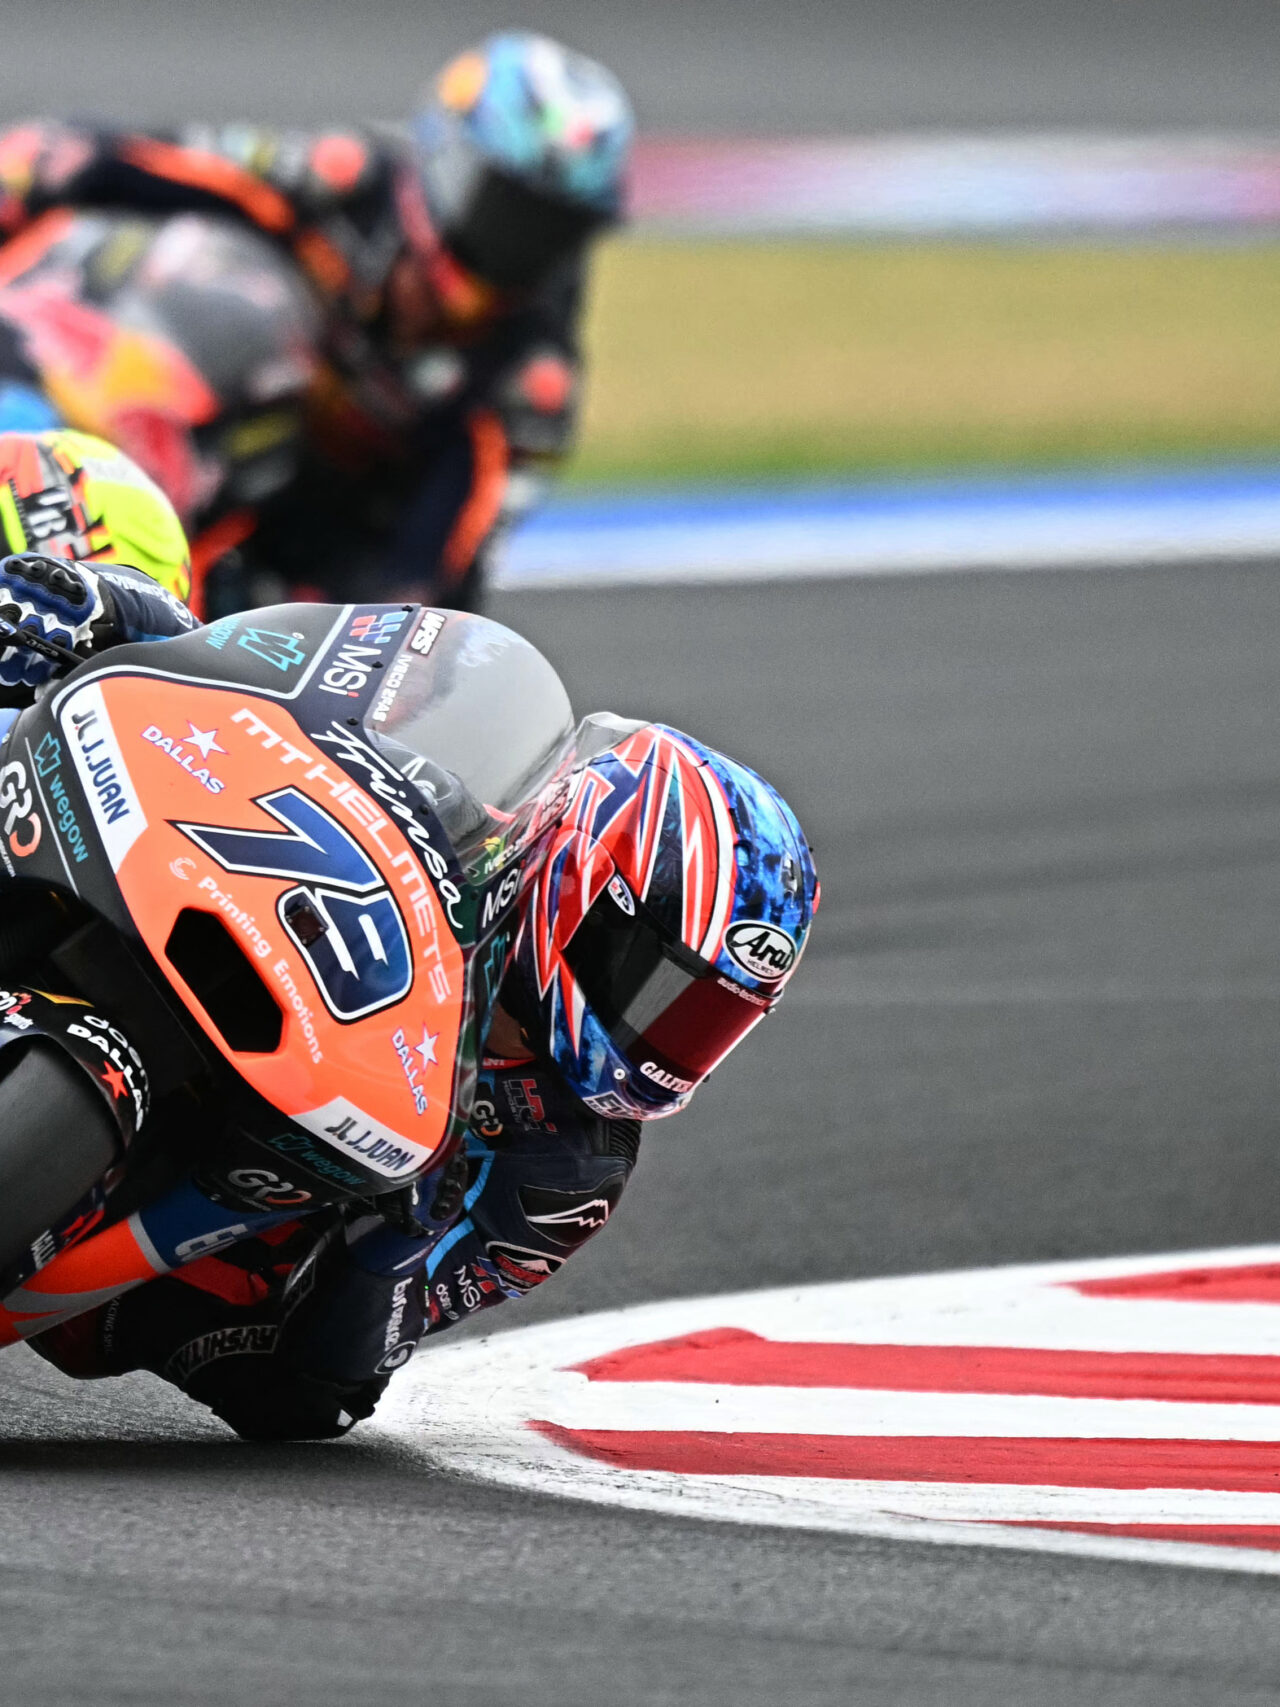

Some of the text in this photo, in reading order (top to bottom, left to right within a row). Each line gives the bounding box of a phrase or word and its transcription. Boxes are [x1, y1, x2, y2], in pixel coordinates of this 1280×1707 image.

[410, 612, 446, 655] WRS
[140, 723, 226, 796] DALLAS
[49, 773, 89, 863] wegow
[230, 707, 451, 1004] MT HELMETS
[198, 876, 324, 1065] Printing Emotions
[730, 931, 792, 971] Arai
[66, 1023, 144, 1132] DALLAS
[391, 1027, 430, 1116] DALLAS
[299, 1147, 368, 1187] wegow
